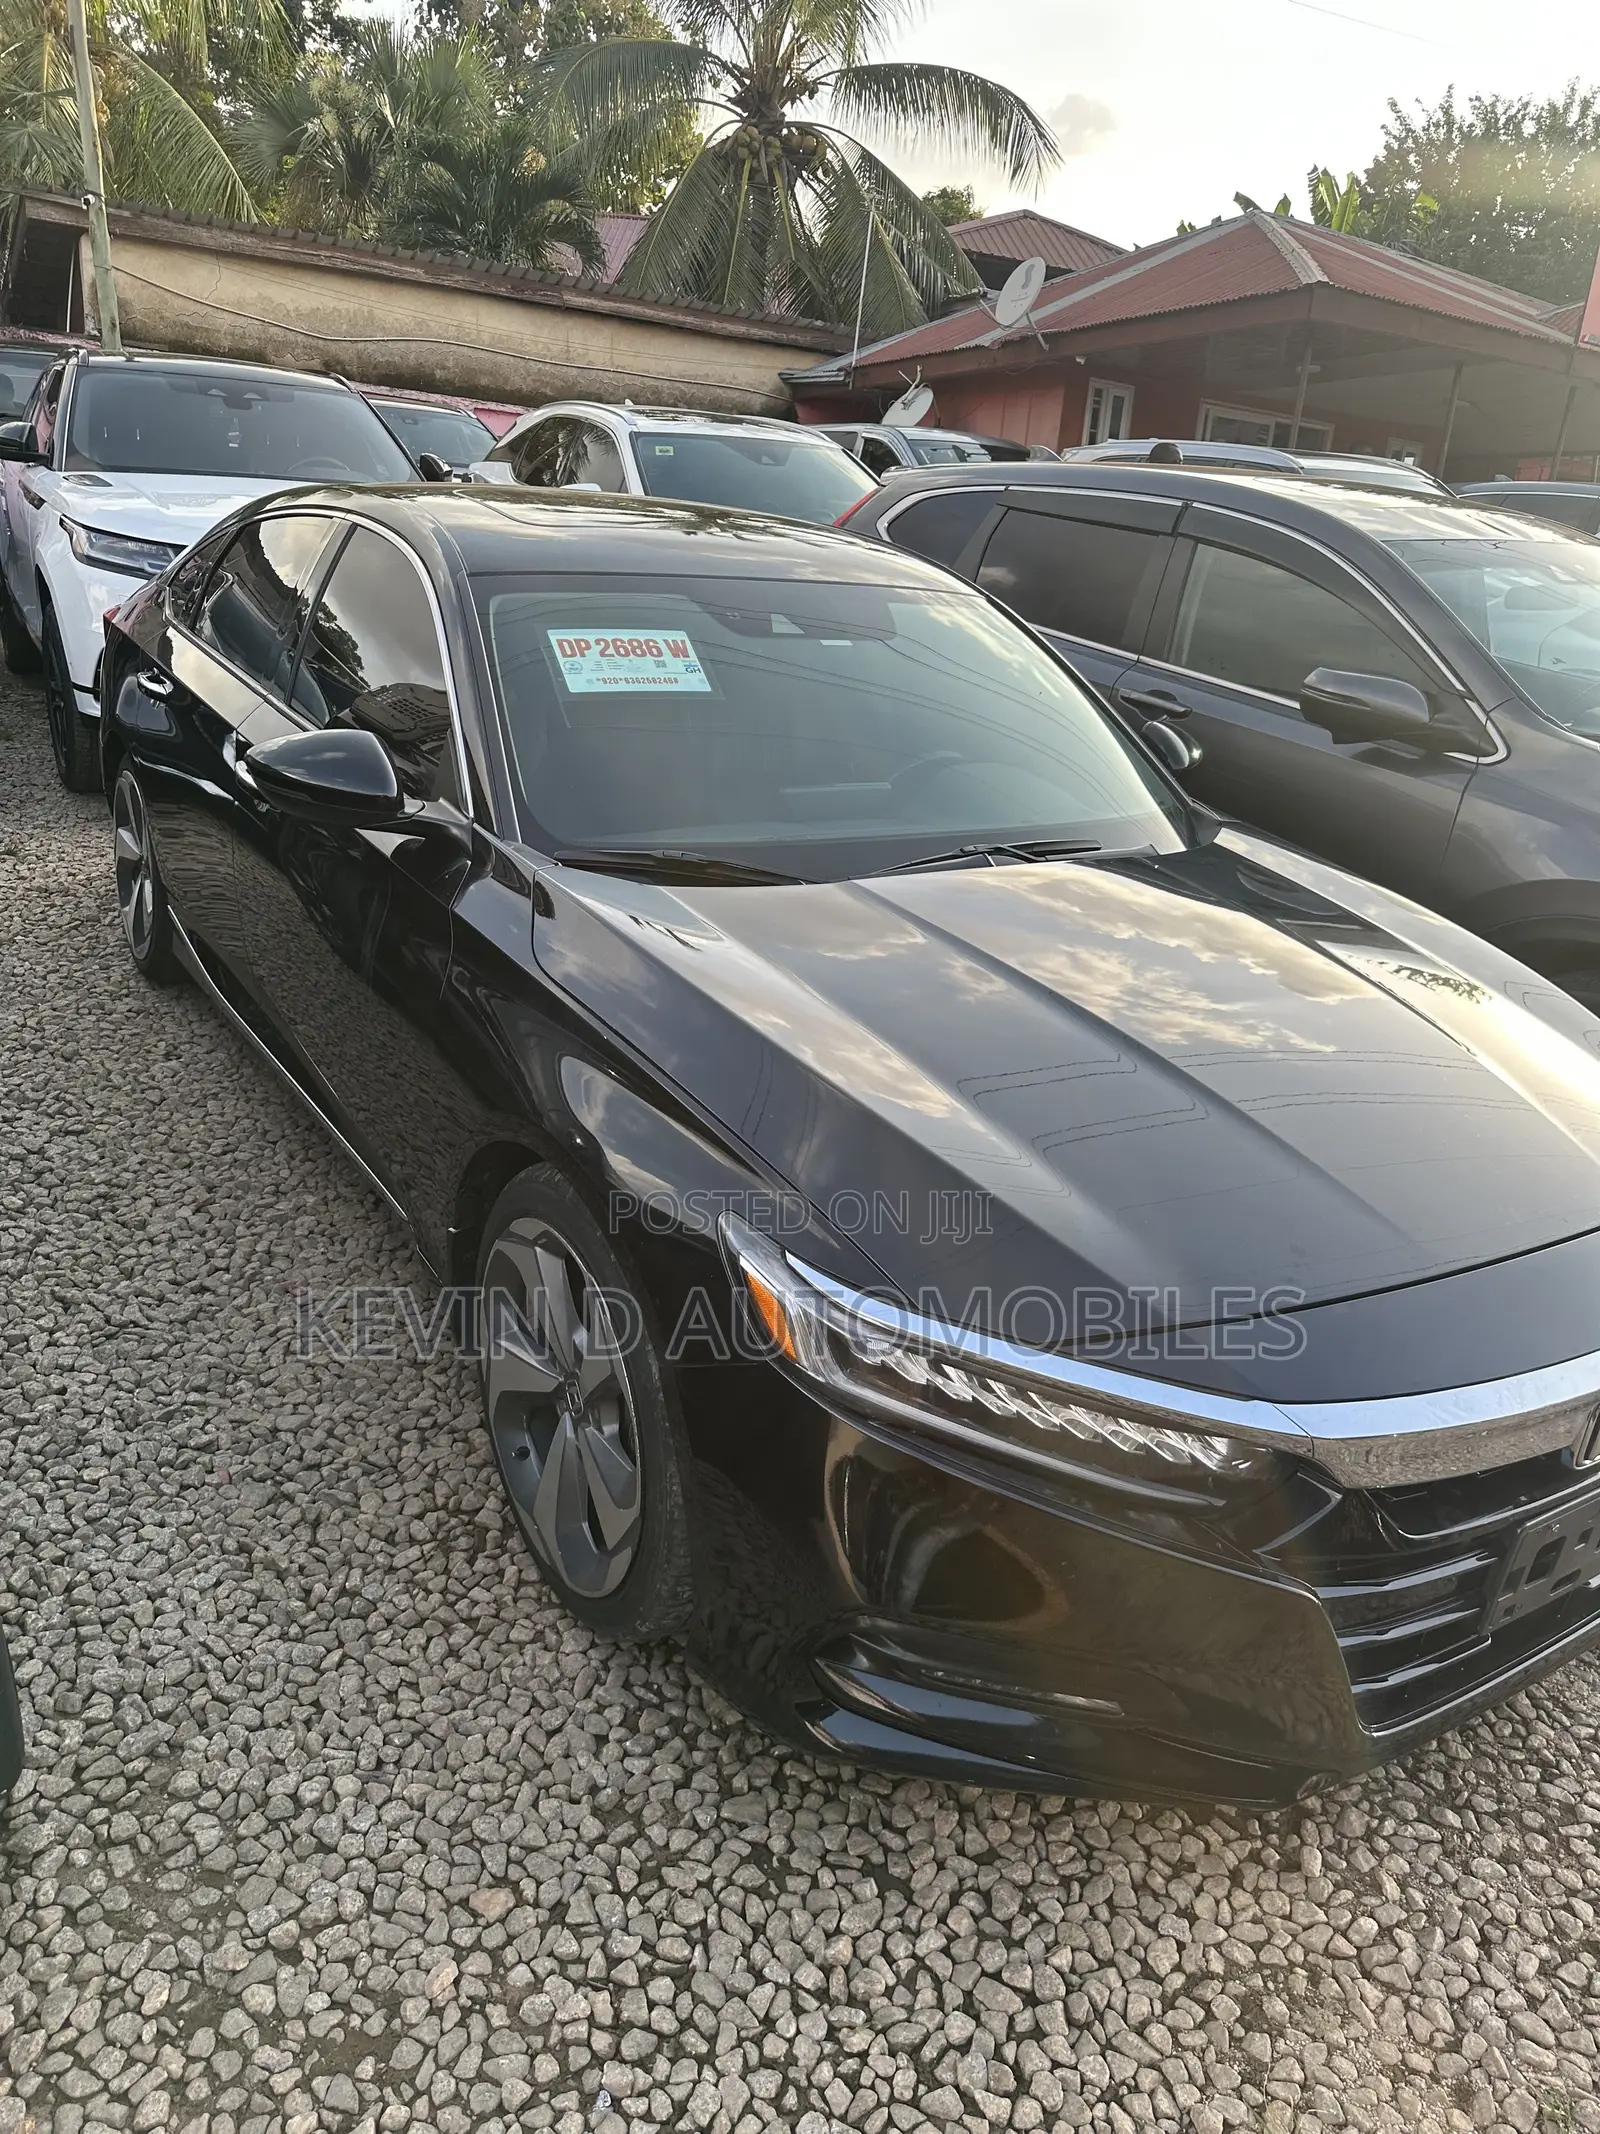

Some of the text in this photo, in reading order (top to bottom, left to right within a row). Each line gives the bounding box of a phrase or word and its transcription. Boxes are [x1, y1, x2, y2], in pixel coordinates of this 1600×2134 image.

[556, 637, 690, 658] DP 2686 W
